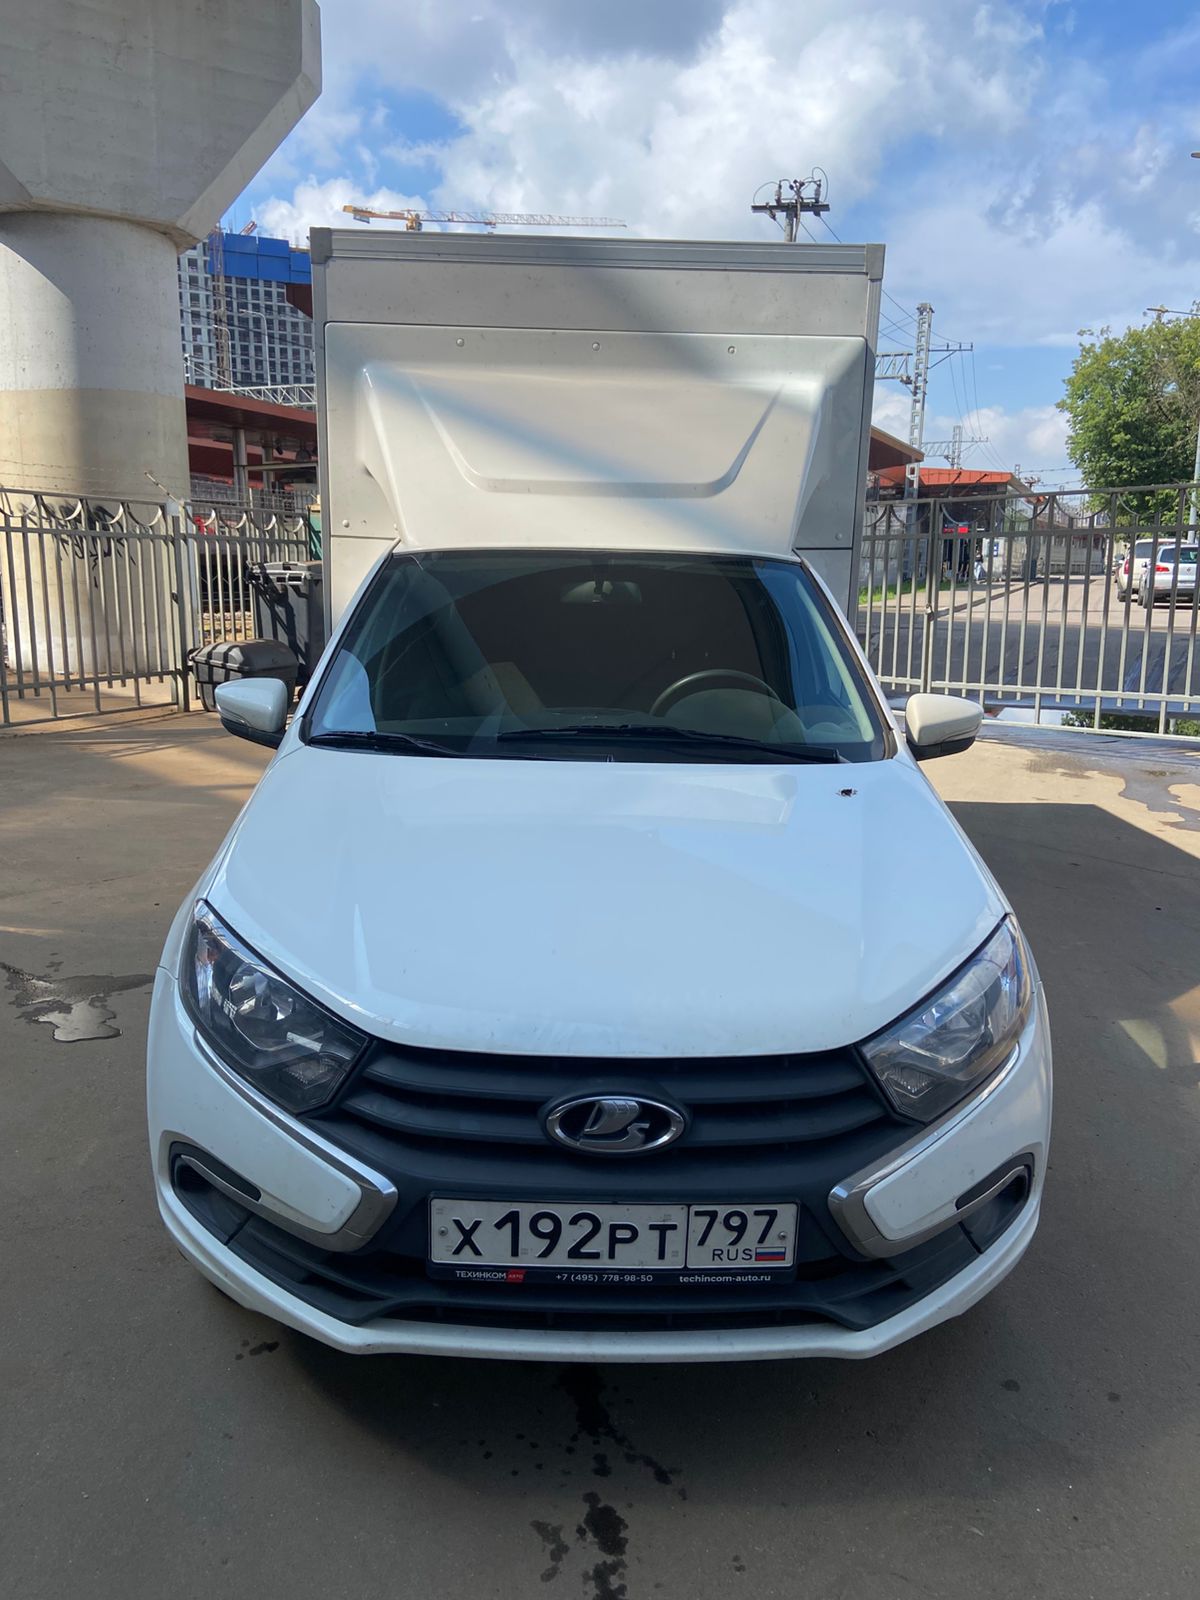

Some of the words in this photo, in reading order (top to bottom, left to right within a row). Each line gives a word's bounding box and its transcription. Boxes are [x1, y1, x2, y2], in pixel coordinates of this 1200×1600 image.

[451, 1209, 678, 1261] Х192РТ
[694, 1209, 779, 1247] 797
[712, 1247, 753, 1262] RUS
[455, 1270, 507, 1279] ТЕХИНКОМ
[570, 1273, 598, 1282] (495)
[602, 1274, 653, 1282] 778-98-50
[679, 1274, 771, 1283] techincom-auto.ru
